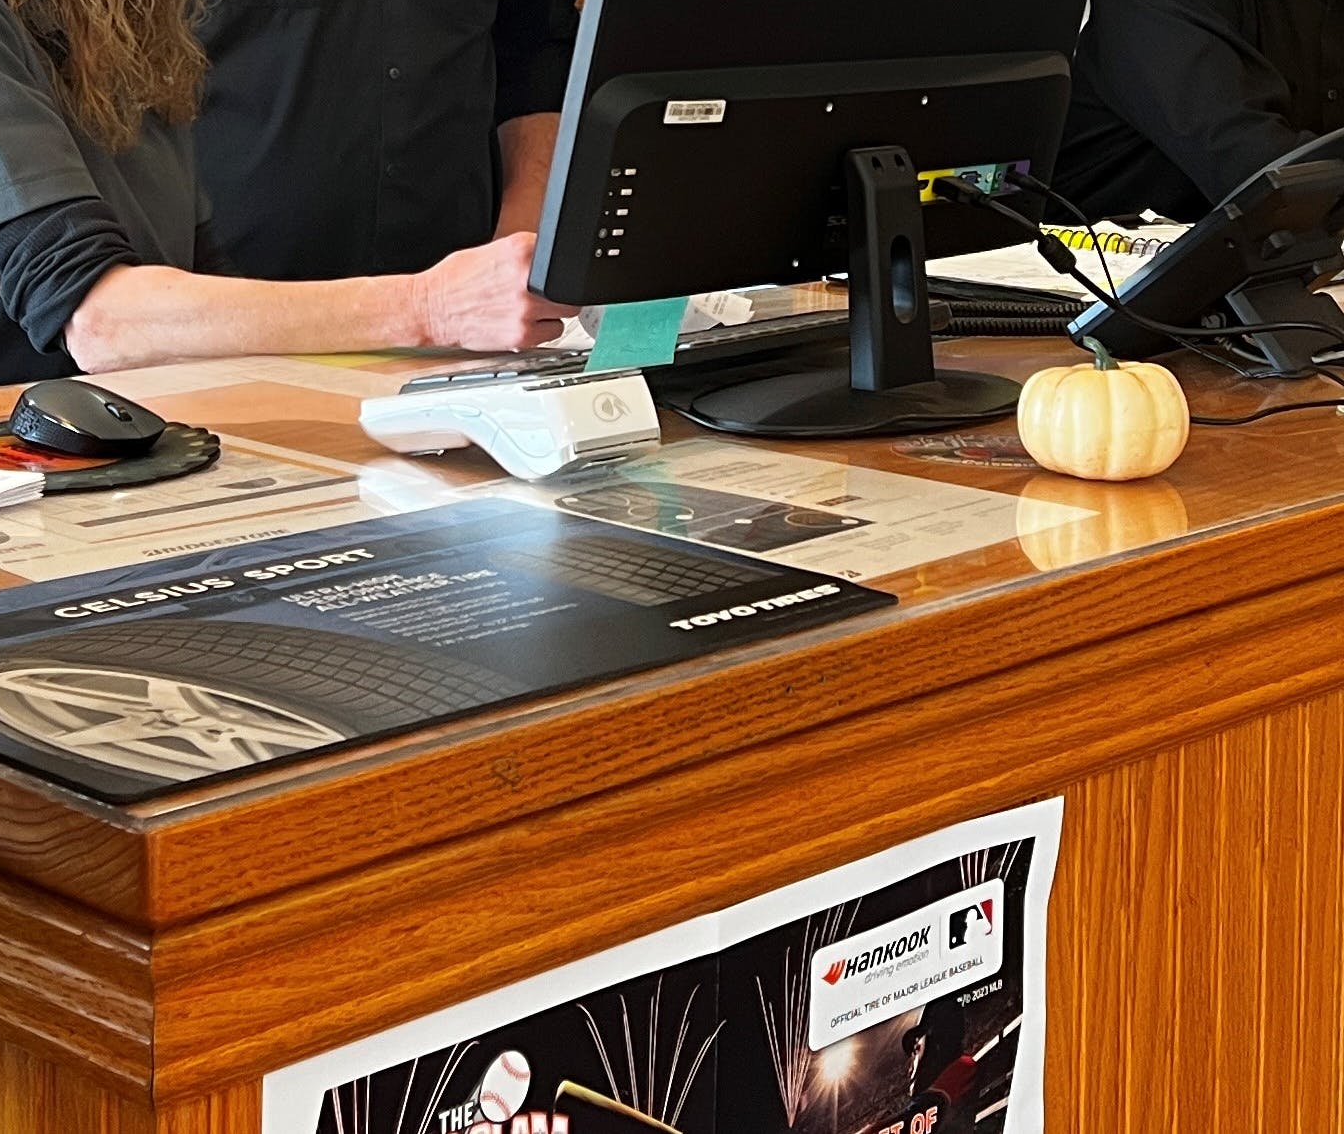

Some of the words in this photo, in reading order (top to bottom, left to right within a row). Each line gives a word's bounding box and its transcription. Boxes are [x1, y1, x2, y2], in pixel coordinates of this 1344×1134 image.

[53, 576, 235, 619] CELSIUS
[243, 548, 376, 581] SPORT
[843, 925, 932, 980] HANKOOK
[830, 1008, 863, 1028] OFFICIAL
[864, 1000, 880, 1013] TIRE
[881, 994, 892, 1006] OF
[893, 983, 920, 1001] MAJOR
[920, 969, 948, 990] LEAGUE
[948, 955, 984, 978] BASEBALL
[438, 1101, 475, 1134] THE
